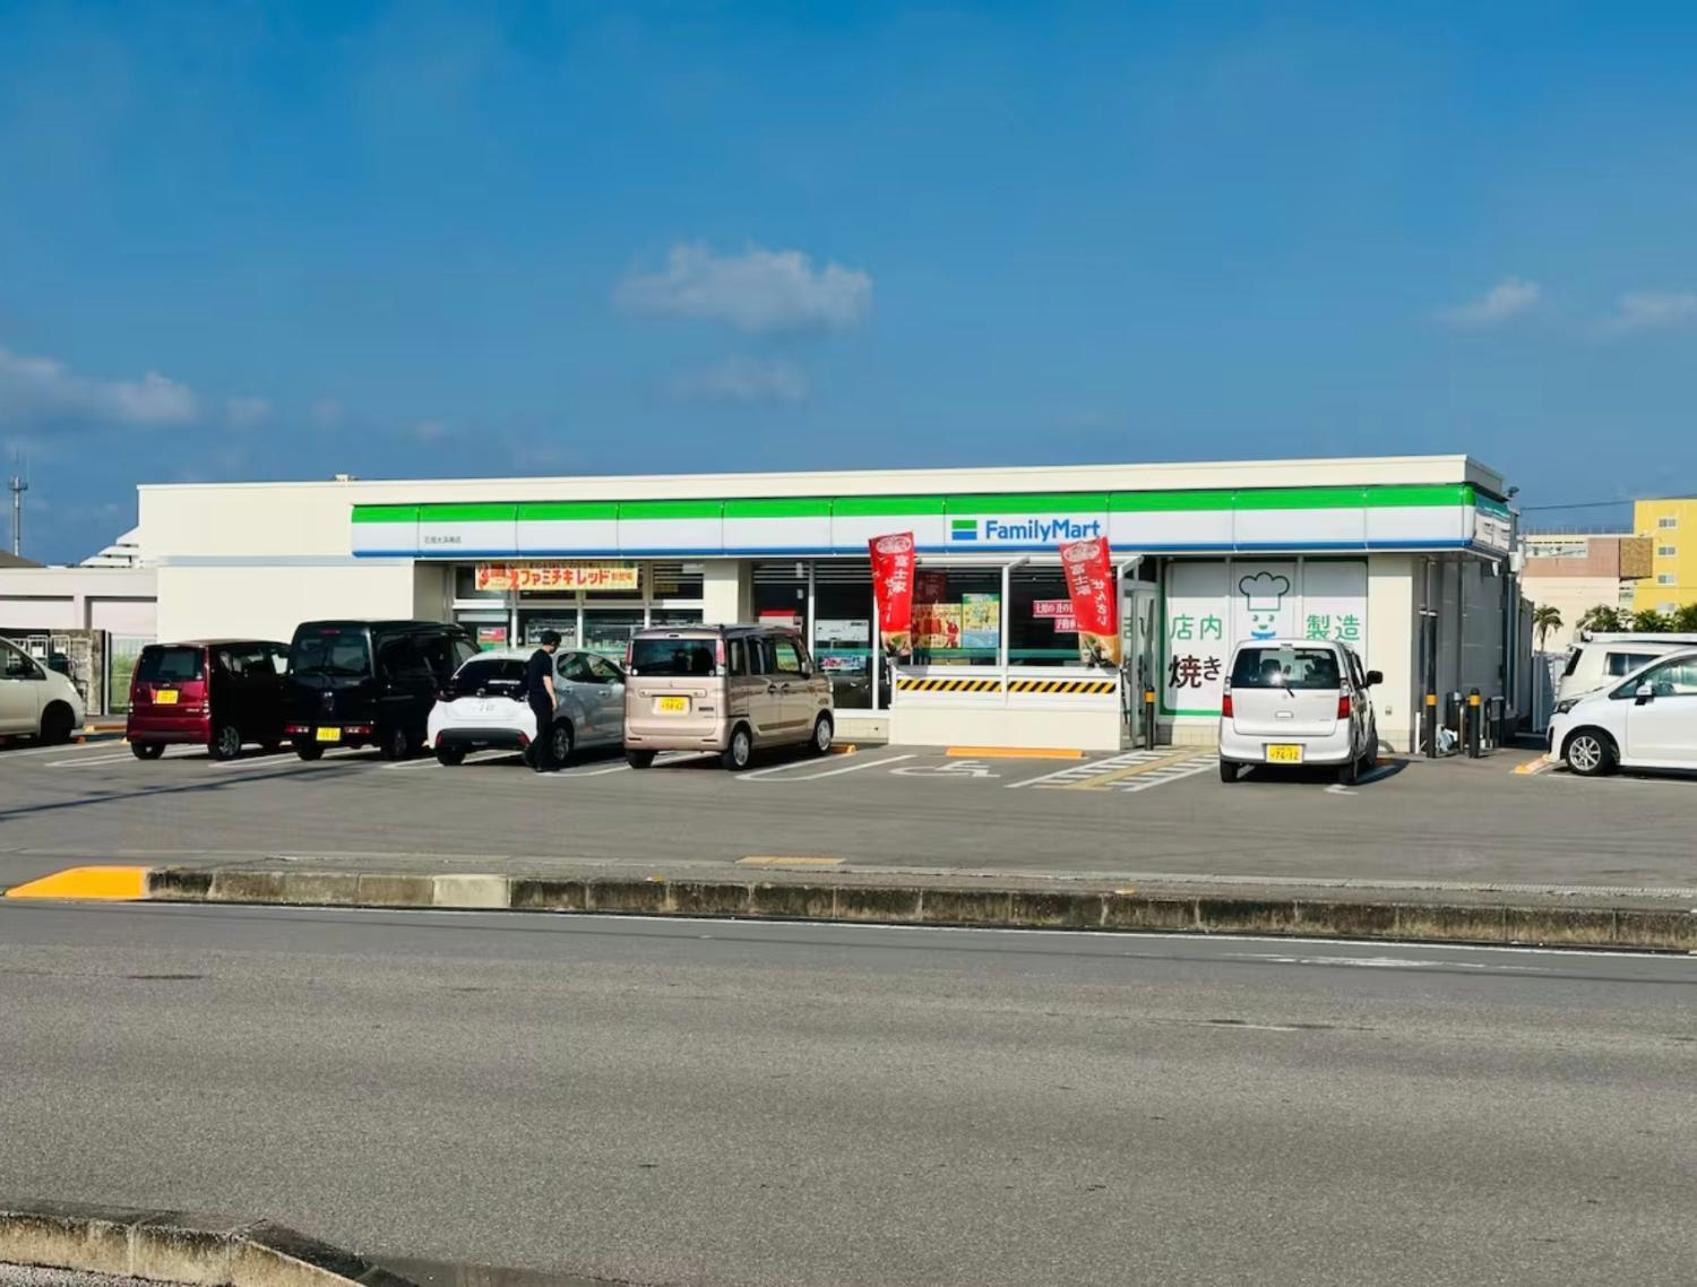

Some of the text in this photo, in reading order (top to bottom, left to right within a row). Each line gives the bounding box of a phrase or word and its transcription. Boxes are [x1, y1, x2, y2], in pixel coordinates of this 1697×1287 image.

[986, 519, 1100, 541] FamilyMart
[1170, 614, 1223, 640] 店内
[1306, 614, 1360, 640] 製造
[1168, 654, 1222, 689] 焼き
